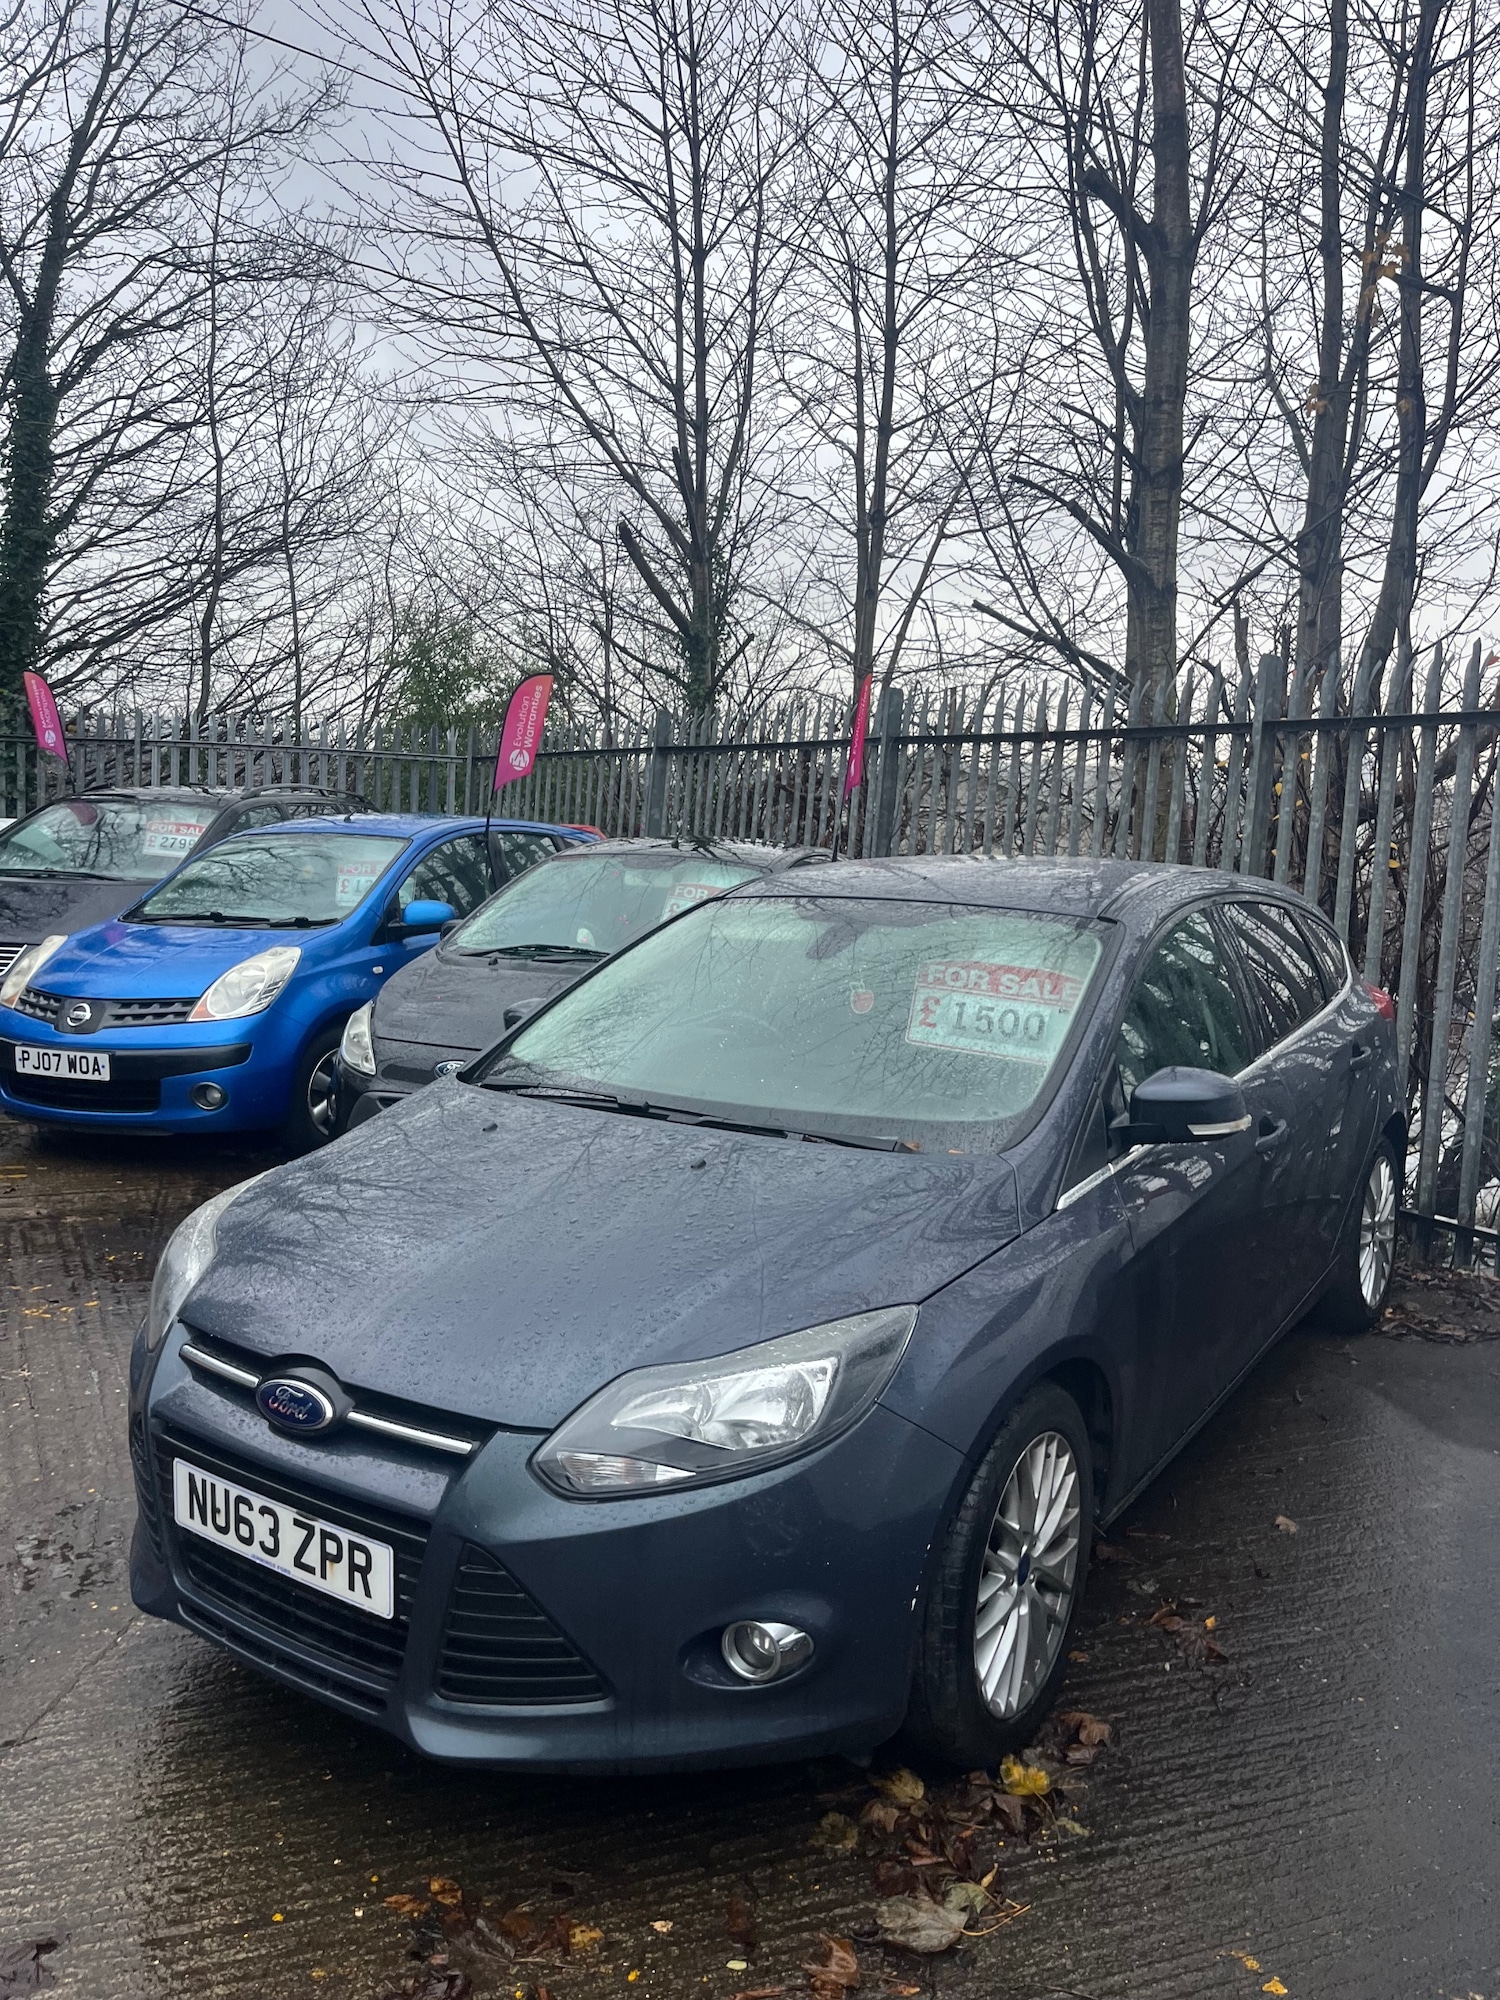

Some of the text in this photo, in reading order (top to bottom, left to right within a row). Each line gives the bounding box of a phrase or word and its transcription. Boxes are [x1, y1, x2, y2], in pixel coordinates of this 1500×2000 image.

[513, 696, 530, 747] Evolution
[523, 685, 542, 748] Warranties
[151, 824, 176, 832] FOR
[344, 863, 371, 874] FOR
[674, 886, 708, 899] FOR
[928, 964, 1079, 1000] FOR SALE
[21, 1050, 102, 1076] PJ07 WOA
[269, 1386, 313, 1420] Ford
[188, 1472, 372, 1599] NU63 ZPR
